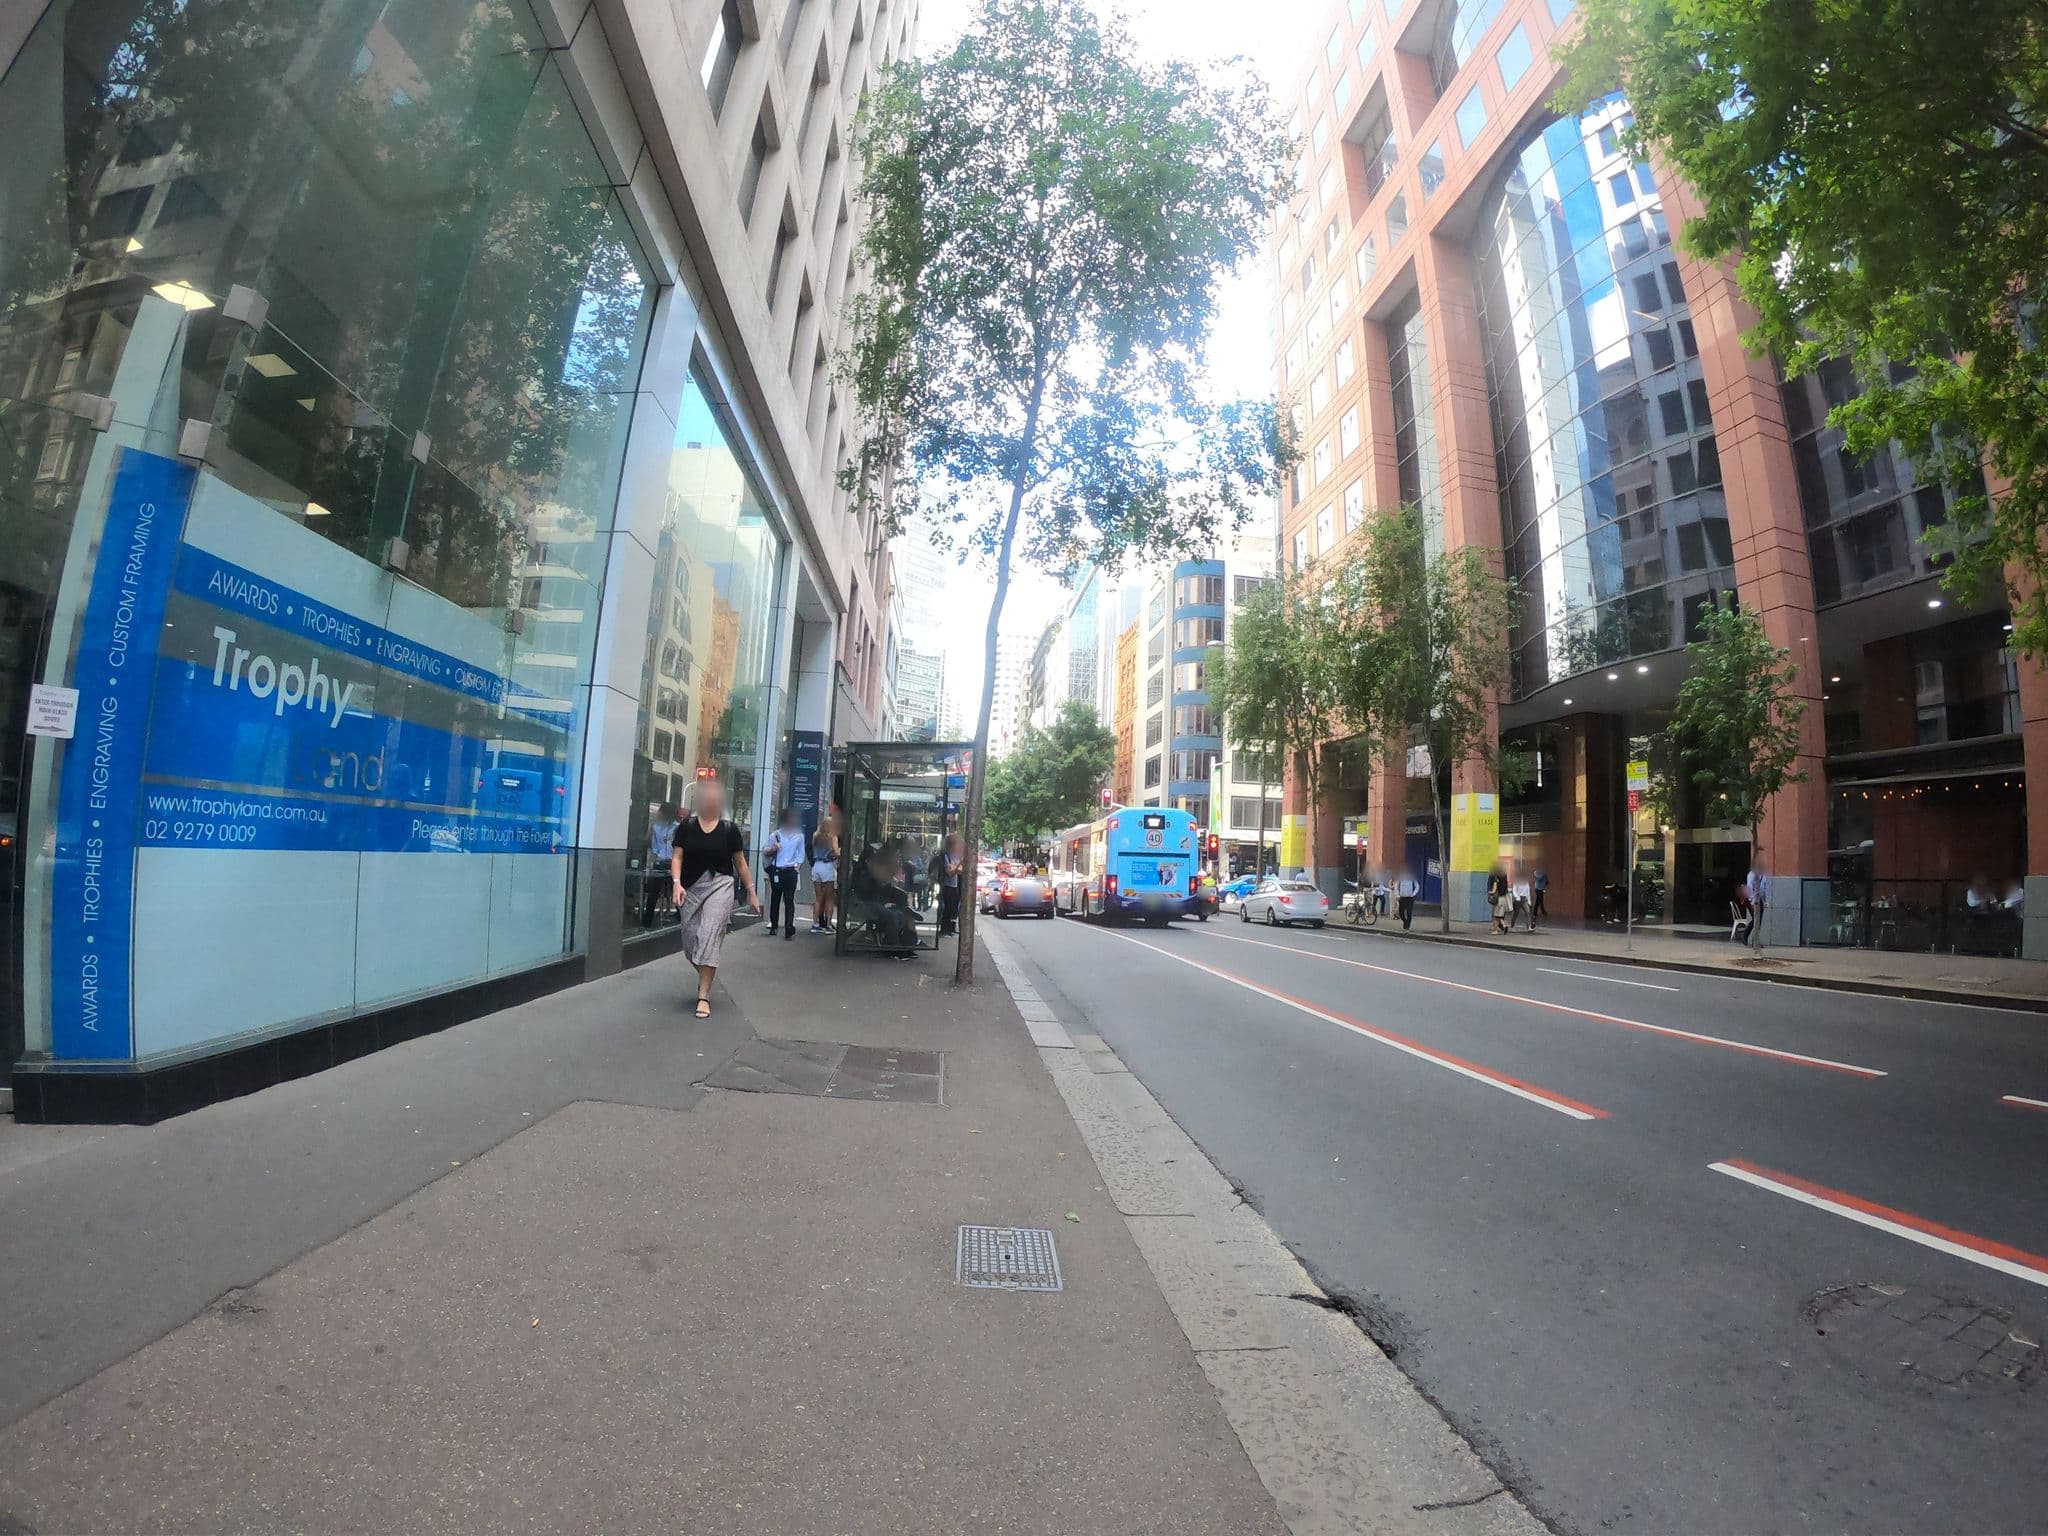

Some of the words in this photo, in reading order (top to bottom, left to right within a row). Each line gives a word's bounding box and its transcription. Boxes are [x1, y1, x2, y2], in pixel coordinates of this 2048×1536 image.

[123, 502, 156, 585] FRAMING
[108, 589, 137, 667] CUSTOM
[208, 570, 279, 615] AWARDS
[302, 606, 361, 647] TROPHIES
[376, 637, 441, 676] ENGRAVING
[455, 668, 492, 696] CUSTOM
[213, 625, 354, 729] Trophy
[90, 697, 118, 809] ENGRAVING
[145, 820, 168, 840] 02
[173, 822, 215, 842] 9279
[219, 823, 257, 842] 0009
[149, 795, 325, 823] www.trophyland.com.au
[481, 824, 514, 846] through
[1148, 833, 1161, 844] 40
[83, 838, 103, 923] TROPHIES
[82, 954, 99, 1031] AWARDS
